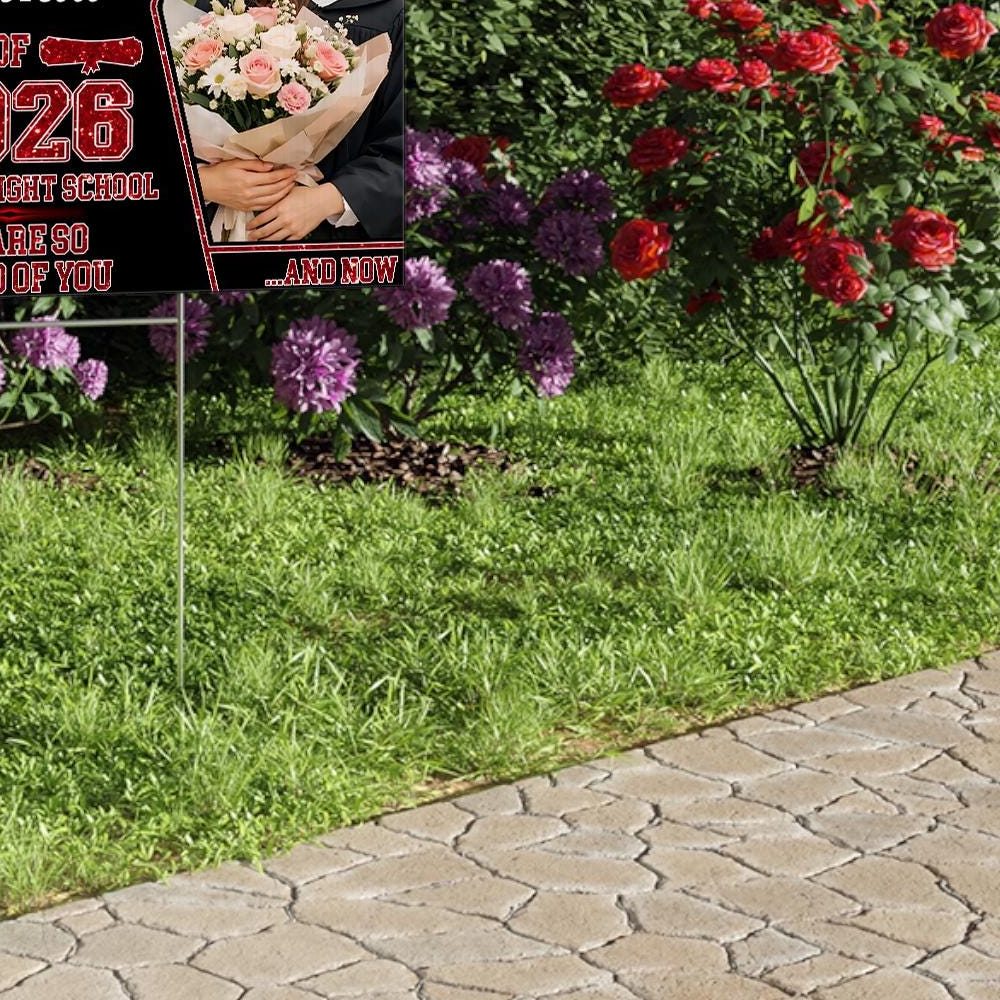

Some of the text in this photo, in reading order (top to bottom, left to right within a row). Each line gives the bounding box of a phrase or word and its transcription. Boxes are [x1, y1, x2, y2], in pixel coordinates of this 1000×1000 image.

[61, 172, 160, 202] SCHOOL
[51, 222, 89, 255] SO
[11, 261, 49, 294] OF
[54, 260, 114, 293] YOU
[340, 256, 399, 286] NOW
